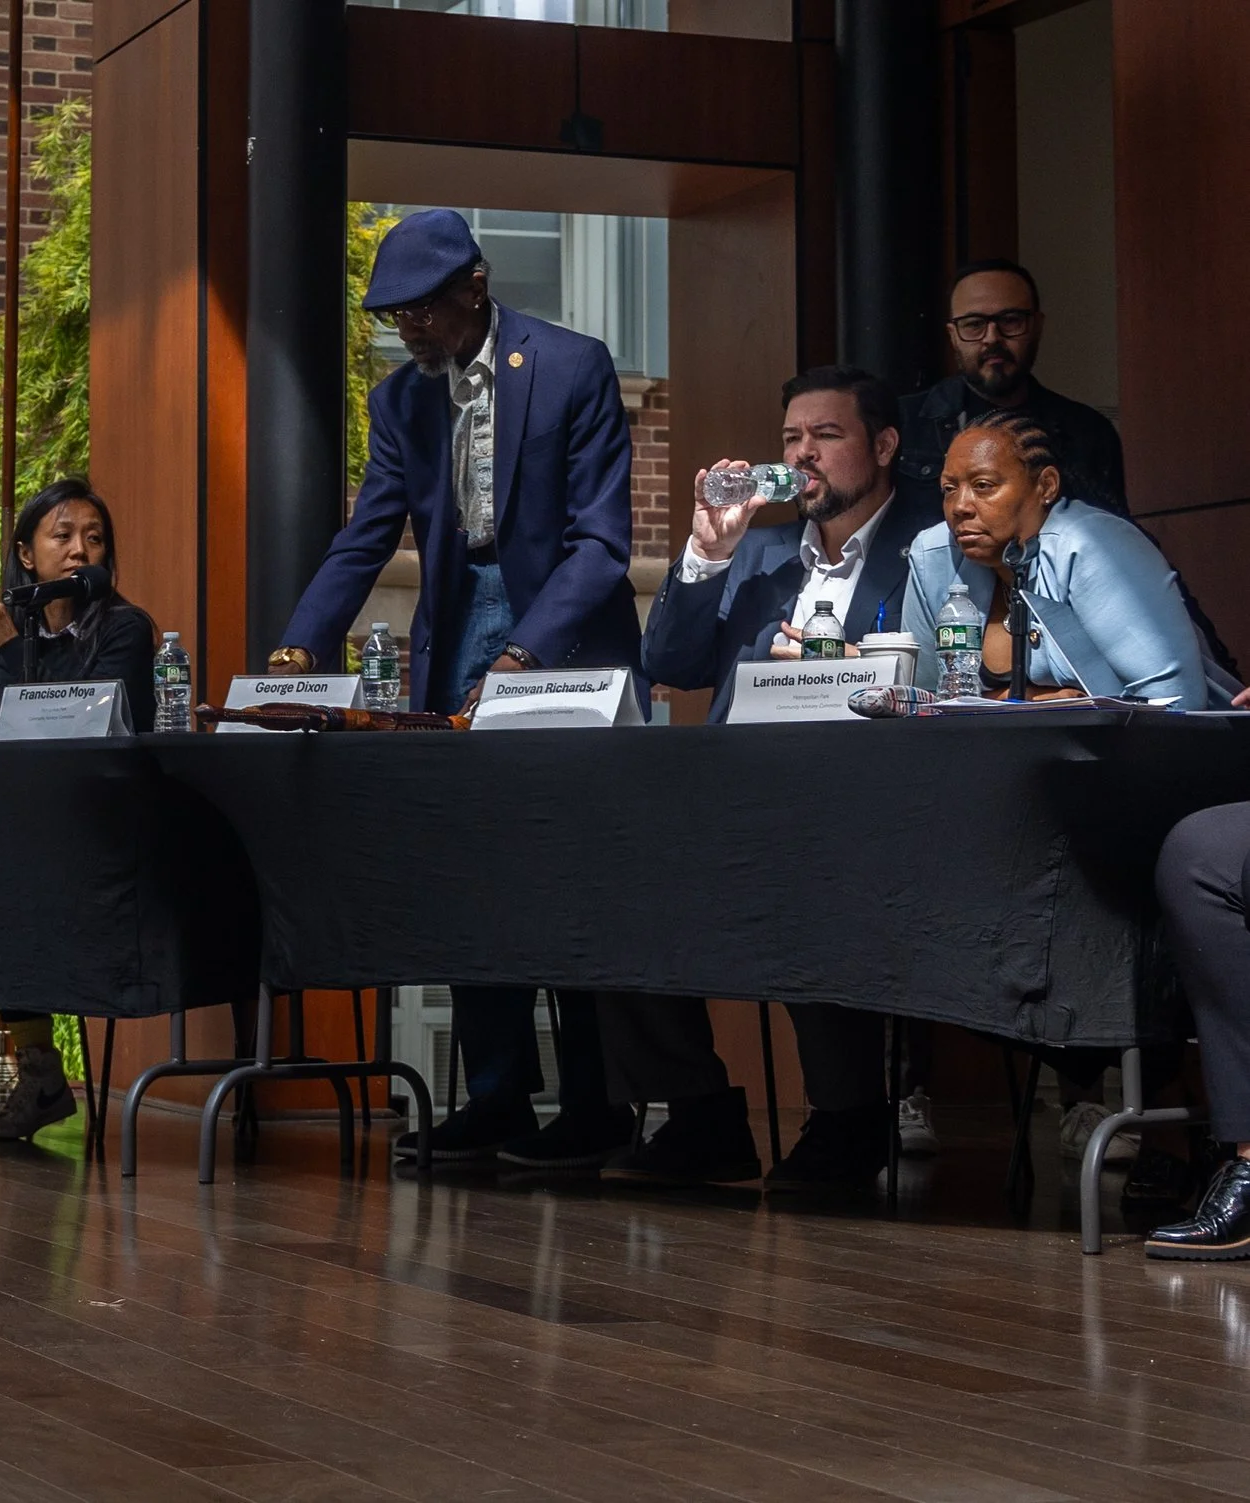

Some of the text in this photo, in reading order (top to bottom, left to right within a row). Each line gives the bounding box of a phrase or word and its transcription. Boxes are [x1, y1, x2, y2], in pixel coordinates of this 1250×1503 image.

[753, 671, 876, 687] Larinda Hooks (Chair)
[19, 686, 96, 700] Francisco Moya
[255, 681, 328, 696] George Dixon
[496, 683, 543, 695] Donovan
[544, 681, 595, 693] Richards,
